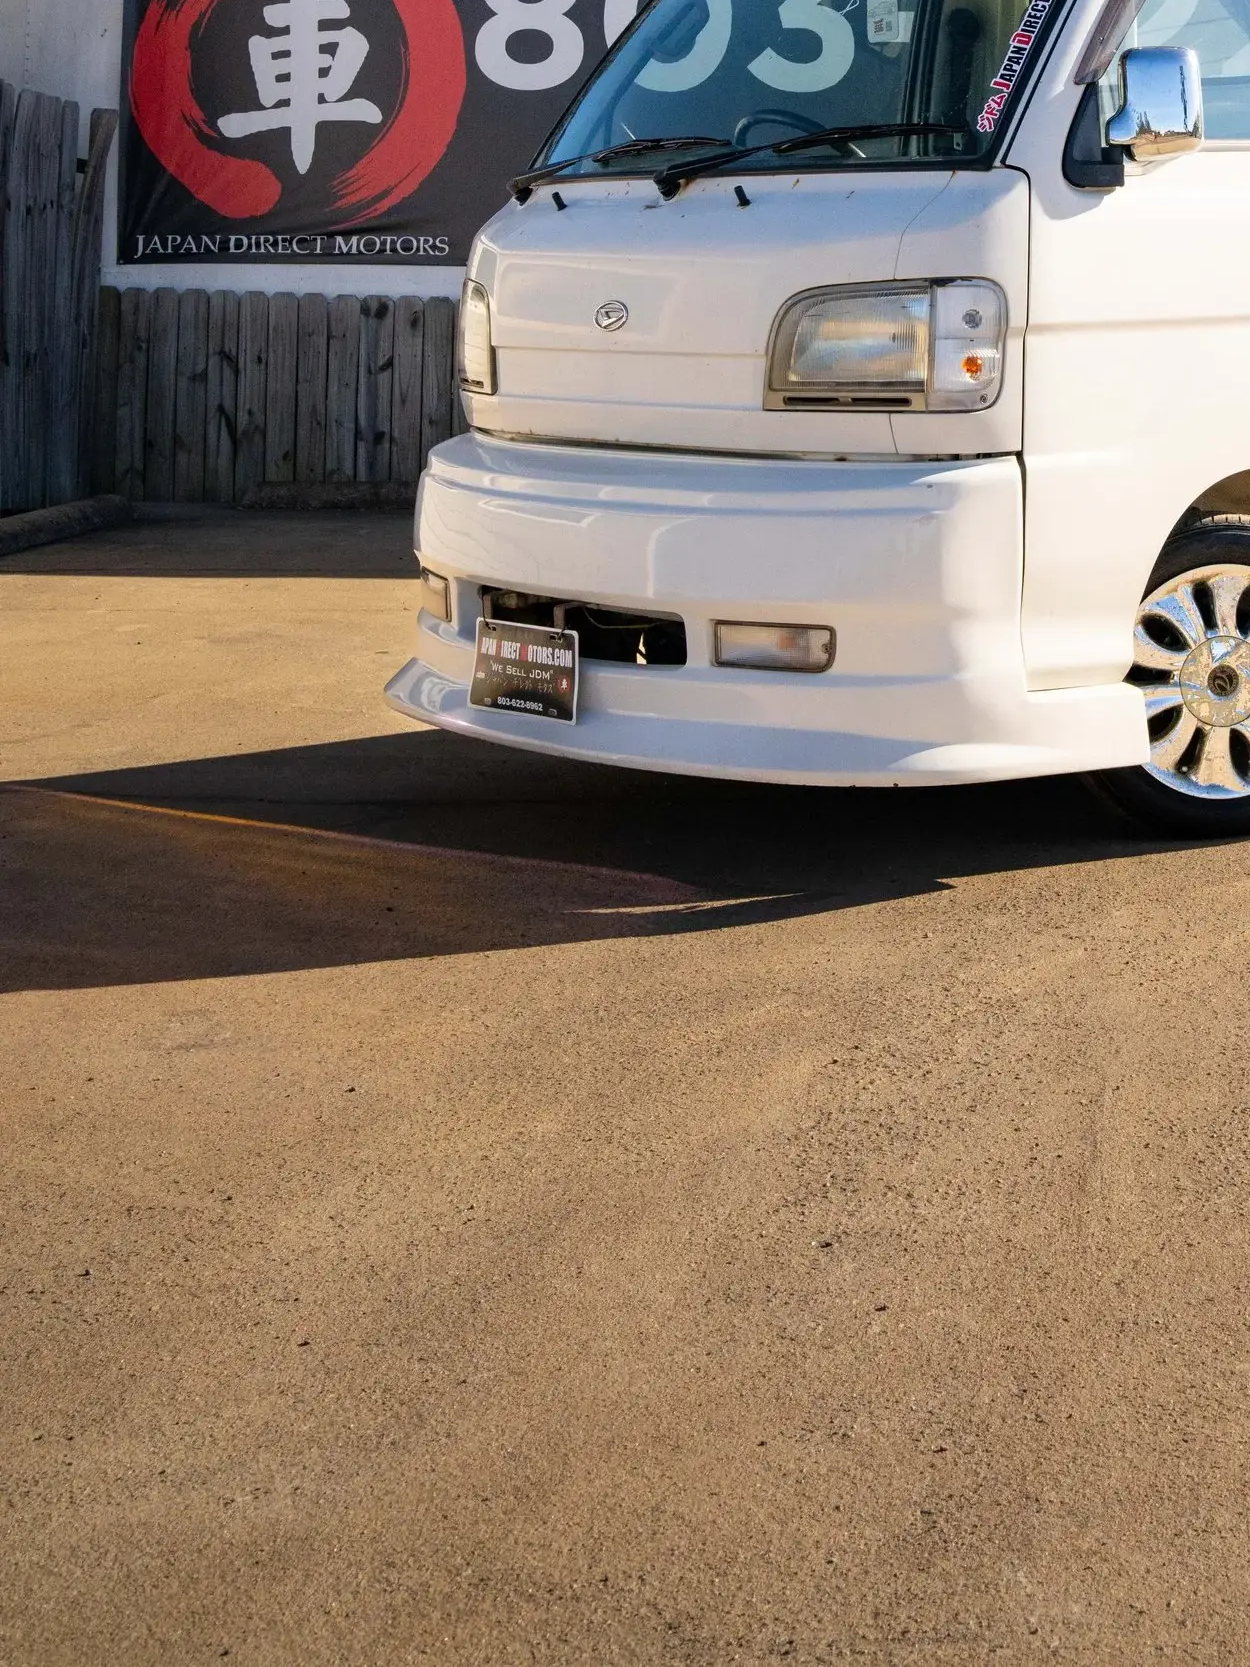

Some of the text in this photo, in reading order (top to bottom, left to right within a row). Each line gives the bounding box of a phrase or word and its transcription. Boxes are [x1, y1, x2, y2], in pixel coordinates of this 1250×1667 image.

[134, 234, 450, 259] JAPAN DIRECT MOTORS
[497, 696, 544, 712] 803-622-8962
